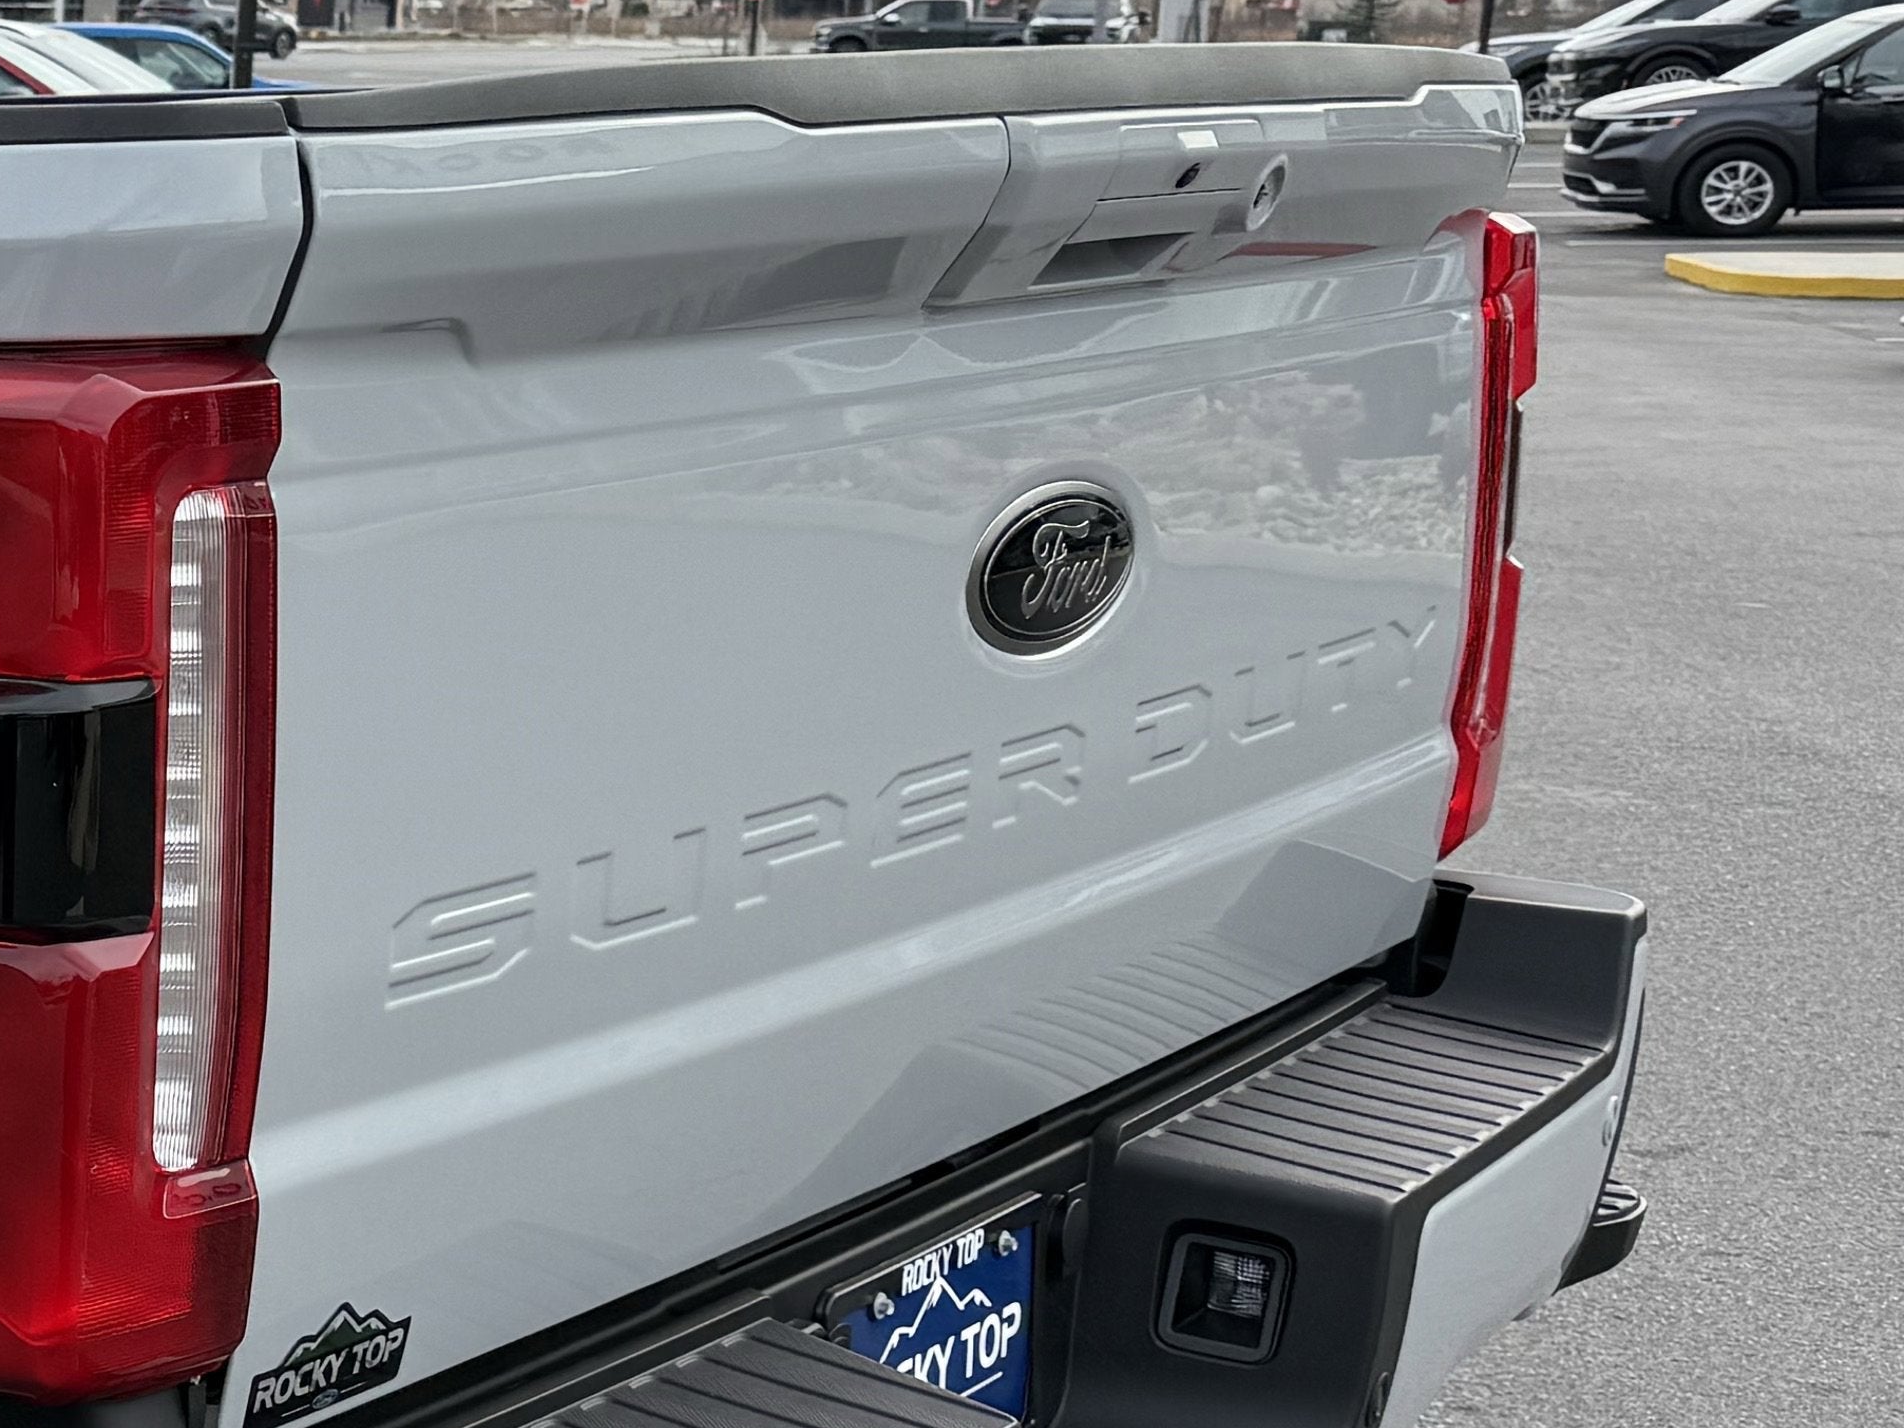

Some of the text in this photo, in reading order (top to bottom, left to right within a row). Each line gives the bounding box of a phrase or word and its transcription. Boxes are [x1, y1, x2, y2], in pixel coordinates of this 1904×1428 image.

[1021, 520, 1112, 619] Ford
[385, 606, 1437, 1011] SUPER DUTY
[901, 1227, 985, 1297] ROCKY TOP
[253, 1327, 405, 1414] ROCKY TOP
[961, 1301, 1022, 1379] TOP
